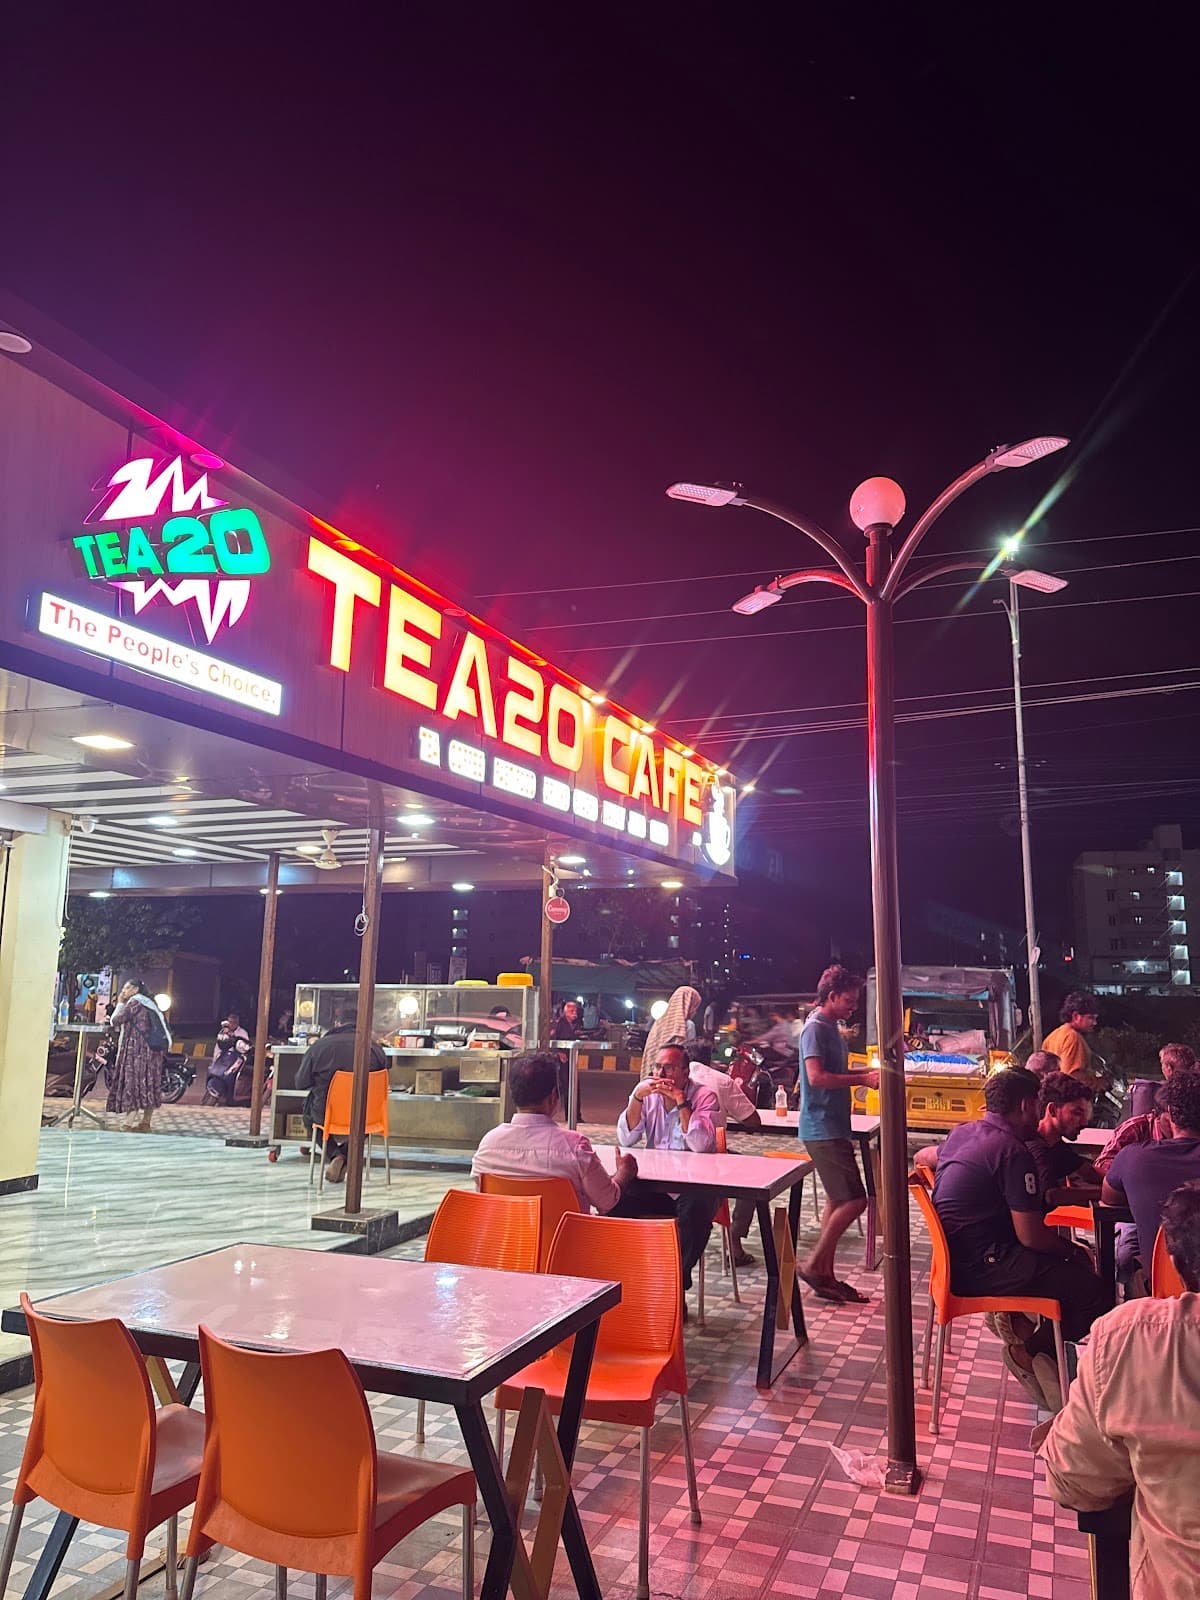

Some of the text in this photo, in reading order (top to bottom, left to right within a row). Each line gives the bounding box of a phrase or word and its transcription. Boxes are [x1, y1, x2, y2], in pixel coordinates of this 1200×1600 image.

[72, 508, 271, 579] TEA20
[50, 601, 97, 638] The
[107, 625, 200, 676] People's
[307, 535, 703, 827] TEA20 CAFE
[1024, 1172, 1037, 1195] 8
